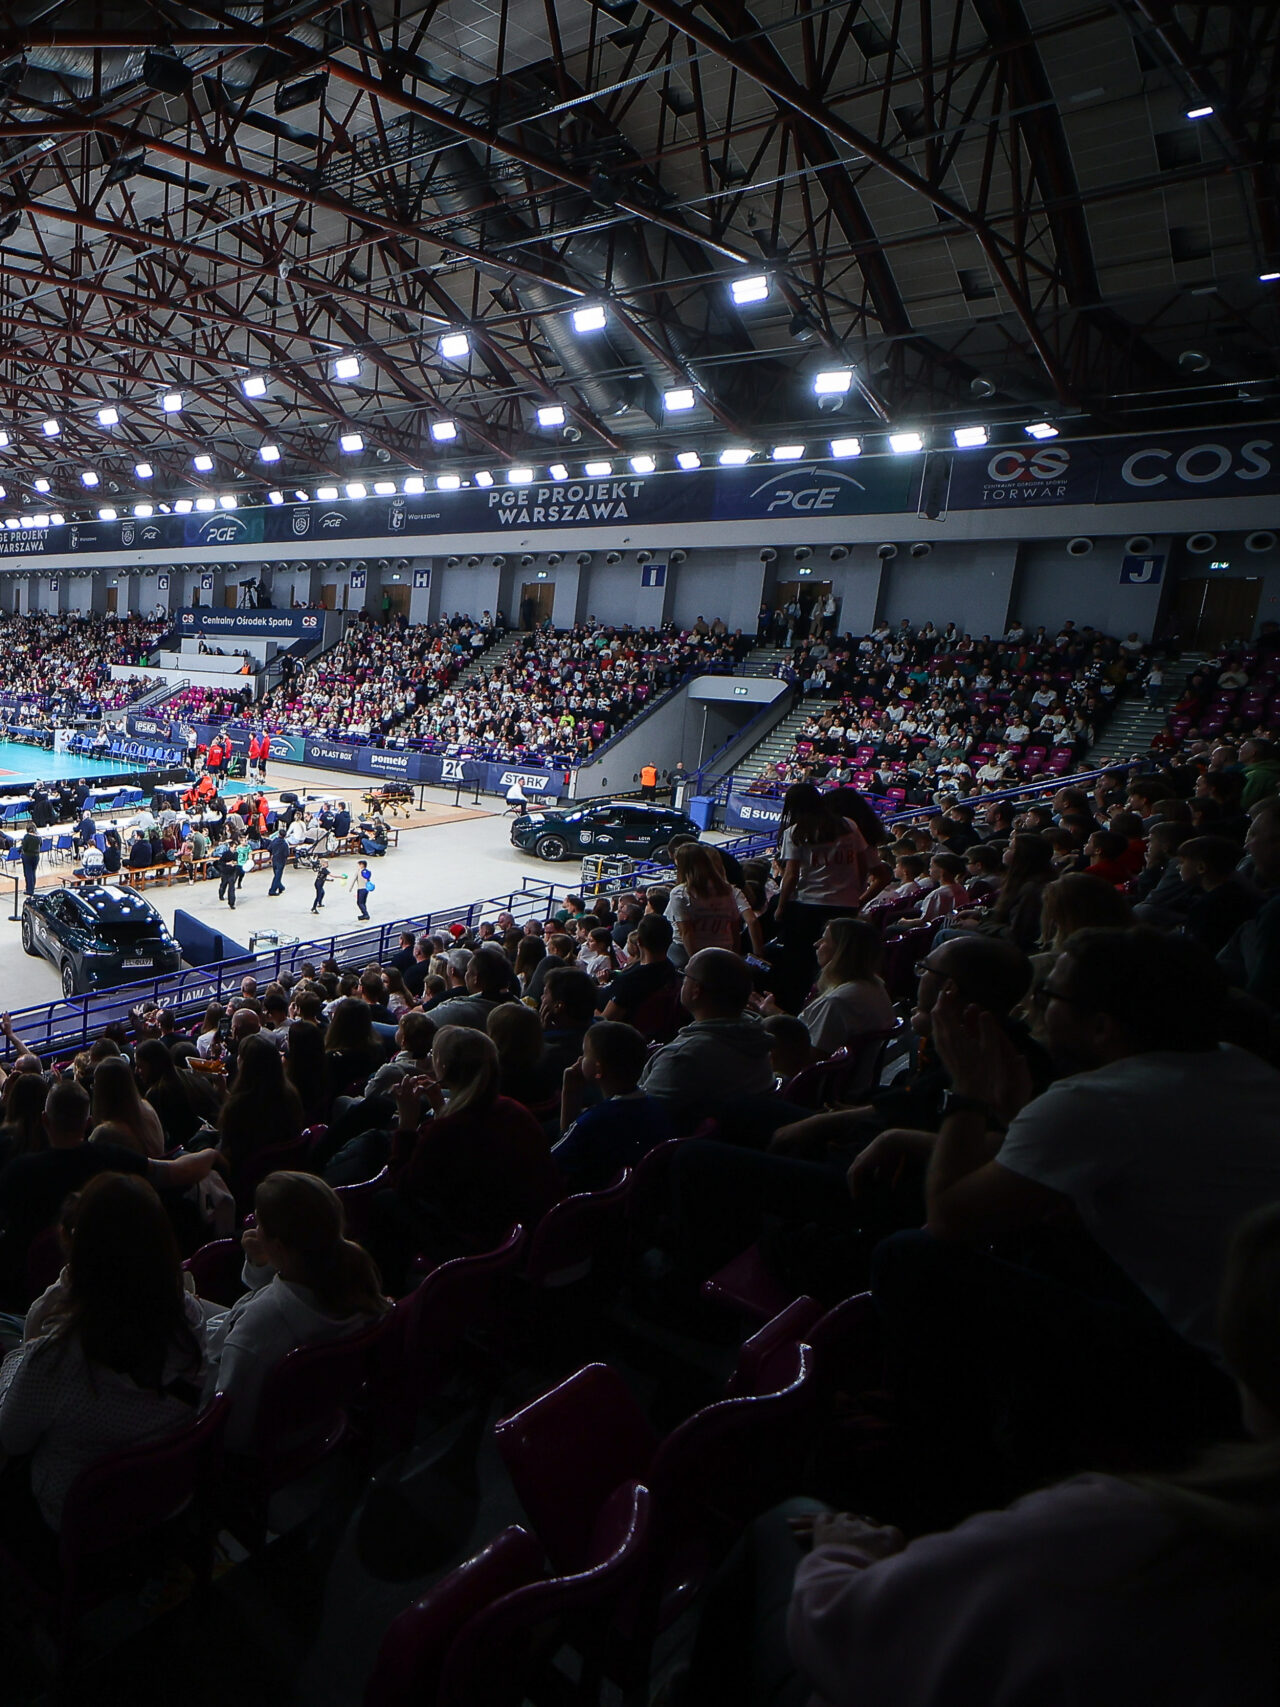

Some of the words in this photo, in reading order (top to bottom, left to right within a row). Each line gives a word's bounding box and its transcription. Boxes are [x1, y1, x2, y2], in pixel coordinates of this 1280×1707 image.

[1121, 440, 1273, 487] COS
[488, 489, 528, 507] PGE
[537, 480, 645, 504] PROJEKT
[767, 487, 840, 511] PGE
[983, 486, 1067, 500] TORWAR
[408, 511, 441, 520] Warszawa
[498, 502, 630, 525] WARSZAWA
[322, 519, 342, 528] PGE
[10, 529, 49, 541] PROJEKT
[206, 527, 238, 542] PGE
[651, 569, 658, 586] I
[1129, 560, 1154, 583] J
[51, 581, 57, 590] F
[159, 577, 168, 589] G
[415, 572, 428, 587] H
[202, 615, 234, 627] Centralny
[236, 615, 267, 626] Ośrodek
[268, 617, 293, 628] Sportu
[268, 744, 288, 756] PGE
[321, 749, 339, 758] PLAST
[340, 752, 352, 760] BOX
[505, 773, 543, 788] STRK
[752, 809, 782, 823] SUW
